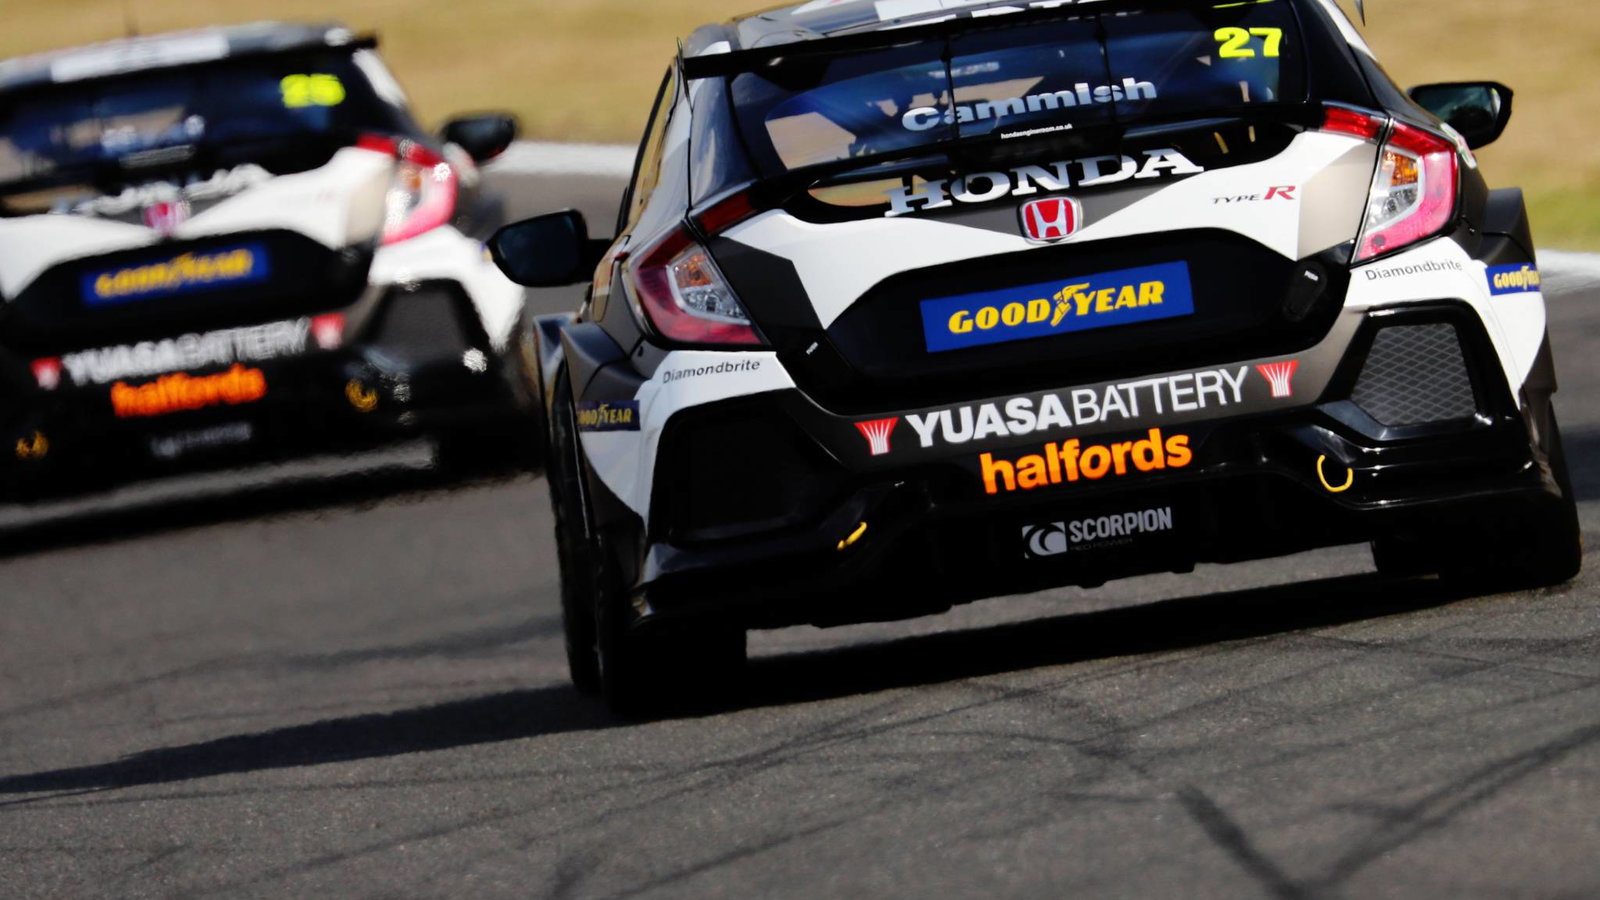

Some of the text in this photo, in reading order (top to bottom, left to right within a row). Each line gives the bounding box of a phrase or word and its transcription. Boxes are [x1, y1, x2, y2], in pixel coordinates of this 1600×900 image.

[1214, 27, 1282, 58] 27
[902, 77, 1157, 132] Cammish
[884, 147, 1205, 218] HONDA
[1212, 185, 1296, 204] TYPE R
[1365, 260, 1463, 281] Diamondbrite
[663, 358, 761, 385] Diamondbrite
[979, 428, 1193, 494] halfords
[1068, 506, 1173, 543] SCORPION
